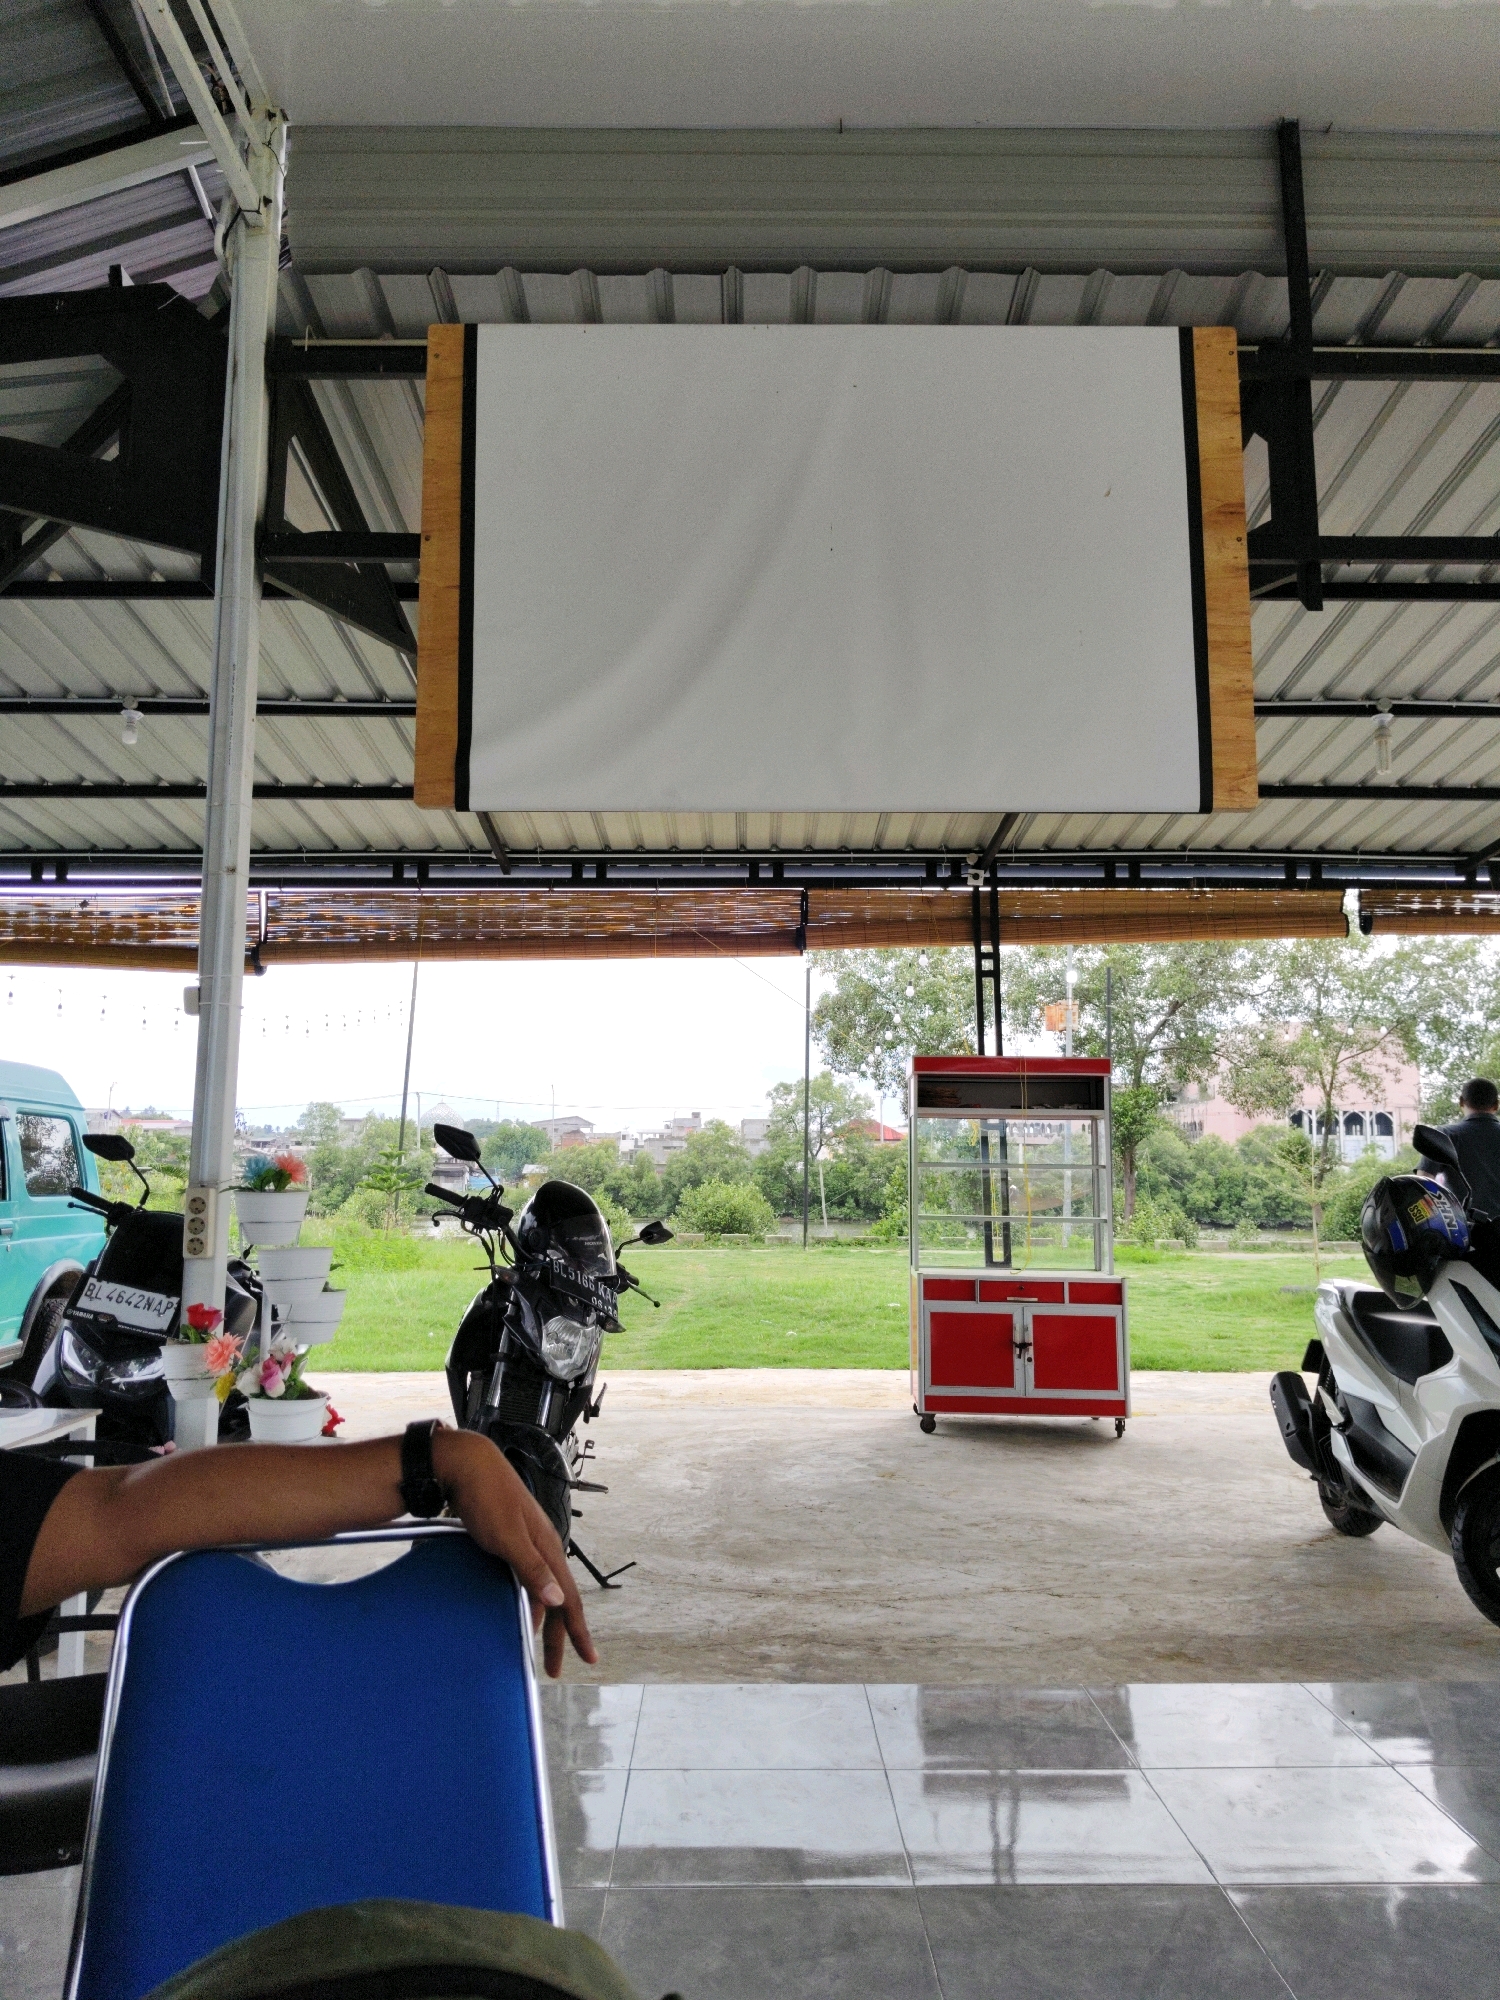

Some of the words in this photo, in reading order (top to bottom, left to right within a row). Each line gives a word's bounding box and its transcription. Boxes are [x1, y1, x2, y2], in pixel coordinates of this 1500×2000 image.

[1434, 1191, 1458, 1230] NHK
[553, 1260, 567, 1278] BL
[84, 1282, 102, 1300] BL
[72, 1309, 94, 1320] YAMAHA
